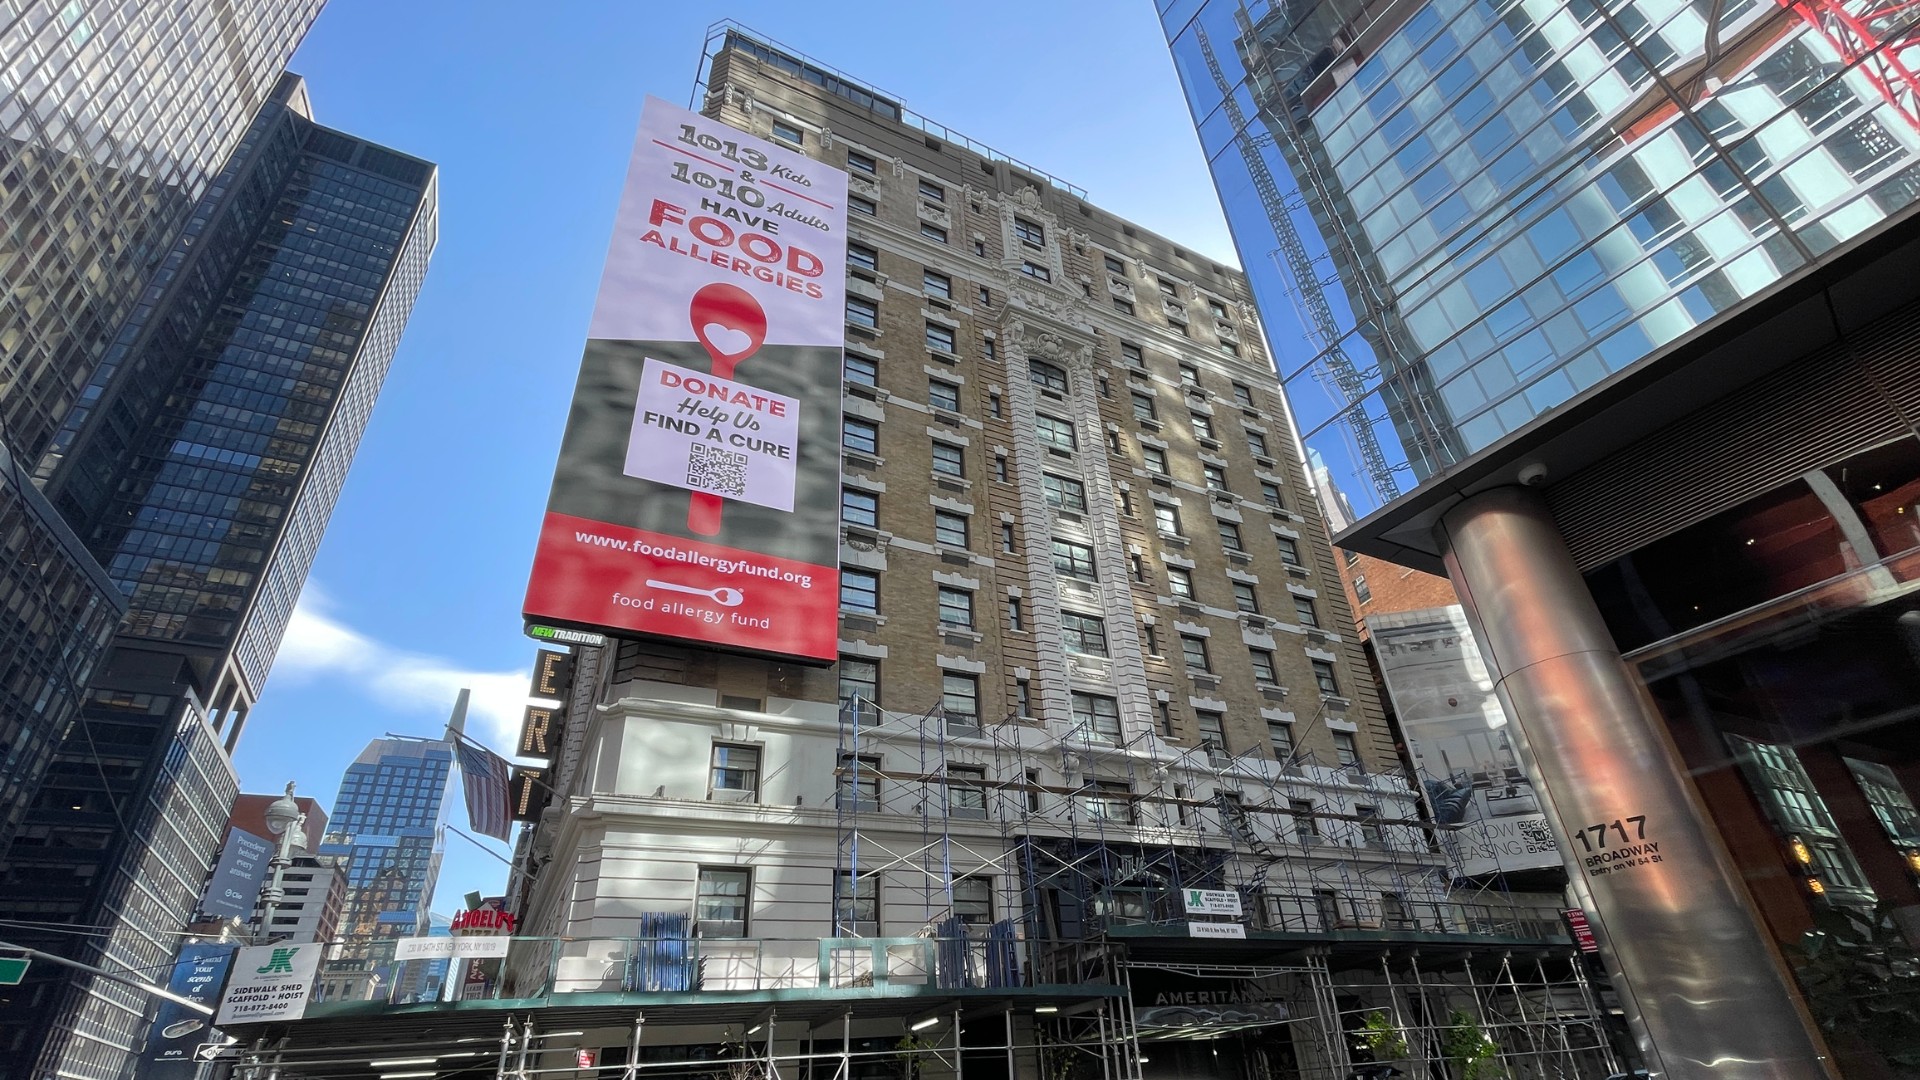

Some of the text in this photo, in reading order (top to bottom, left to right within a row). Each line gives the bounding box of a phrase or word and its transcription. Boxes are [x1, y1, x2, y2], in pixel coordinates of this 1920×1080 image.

[739, 170, 756, 185] &
[770, 164, 812, 188] Kids
[701, 197, 779, 235] HAVE
[766, 202, 830, 232] Adults
[649, 198, 824, 278] FOOD
[640, 229, 823, 299] ALLERGIES
[660, 370, 786, 418] DONATE
[676, 397, 761, 431] Help Us
[643, 410, 791, 460] FIND A CURE
[575, 531, 812, 589] www.foodallergyfund.org
[612, 592, 770, 629] food allergy fund
[1471, 822, 1514, 840] NOW
[1575, 815, 1646, 853] 1717
[237, 835, 266, 854] Precedent
[238, 847, 259, 860] behind
[1585, 842, 1660, 868] BROADWAY
[236, 860, 254, 870] every
[1589, 866, 1611, 877] Entry
[1613, 863, 1626, 871] on
[1638, 857, 1650, 866] 54
[1651, 855, 1663, 863] St
[1187, 891, 1204, 907] JK
[193, 966, 214, 975] your
[256, 947, 301, 974] JK
[184, 994, 204, 1002] lace
[192, 984, 203, 993] of
[227, 992, 304, 1004] SCAFFOLD HOIST
[233, 984, 303, 995] SIDEWALK SHED
[1156, 991, 1273, 1004] AMERITANA
